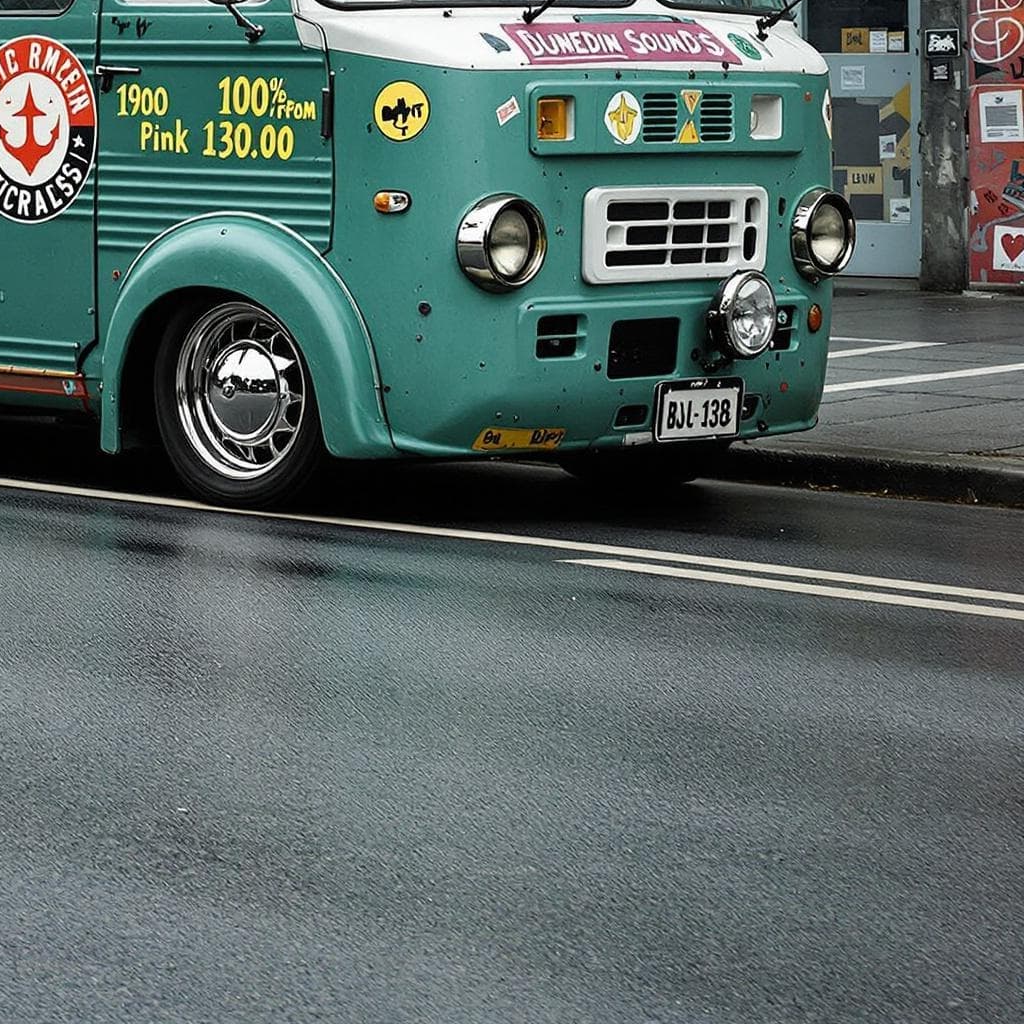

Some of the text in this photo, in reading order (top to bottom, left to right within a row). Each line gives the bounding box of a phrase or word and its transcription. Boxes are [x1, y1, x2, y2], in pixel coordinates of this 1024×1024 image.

[516, 29, 620, 57] DUNEDIN
[116, 83, 169, 118] 1900
[139, 119, 295, 161] Pink 130.00
